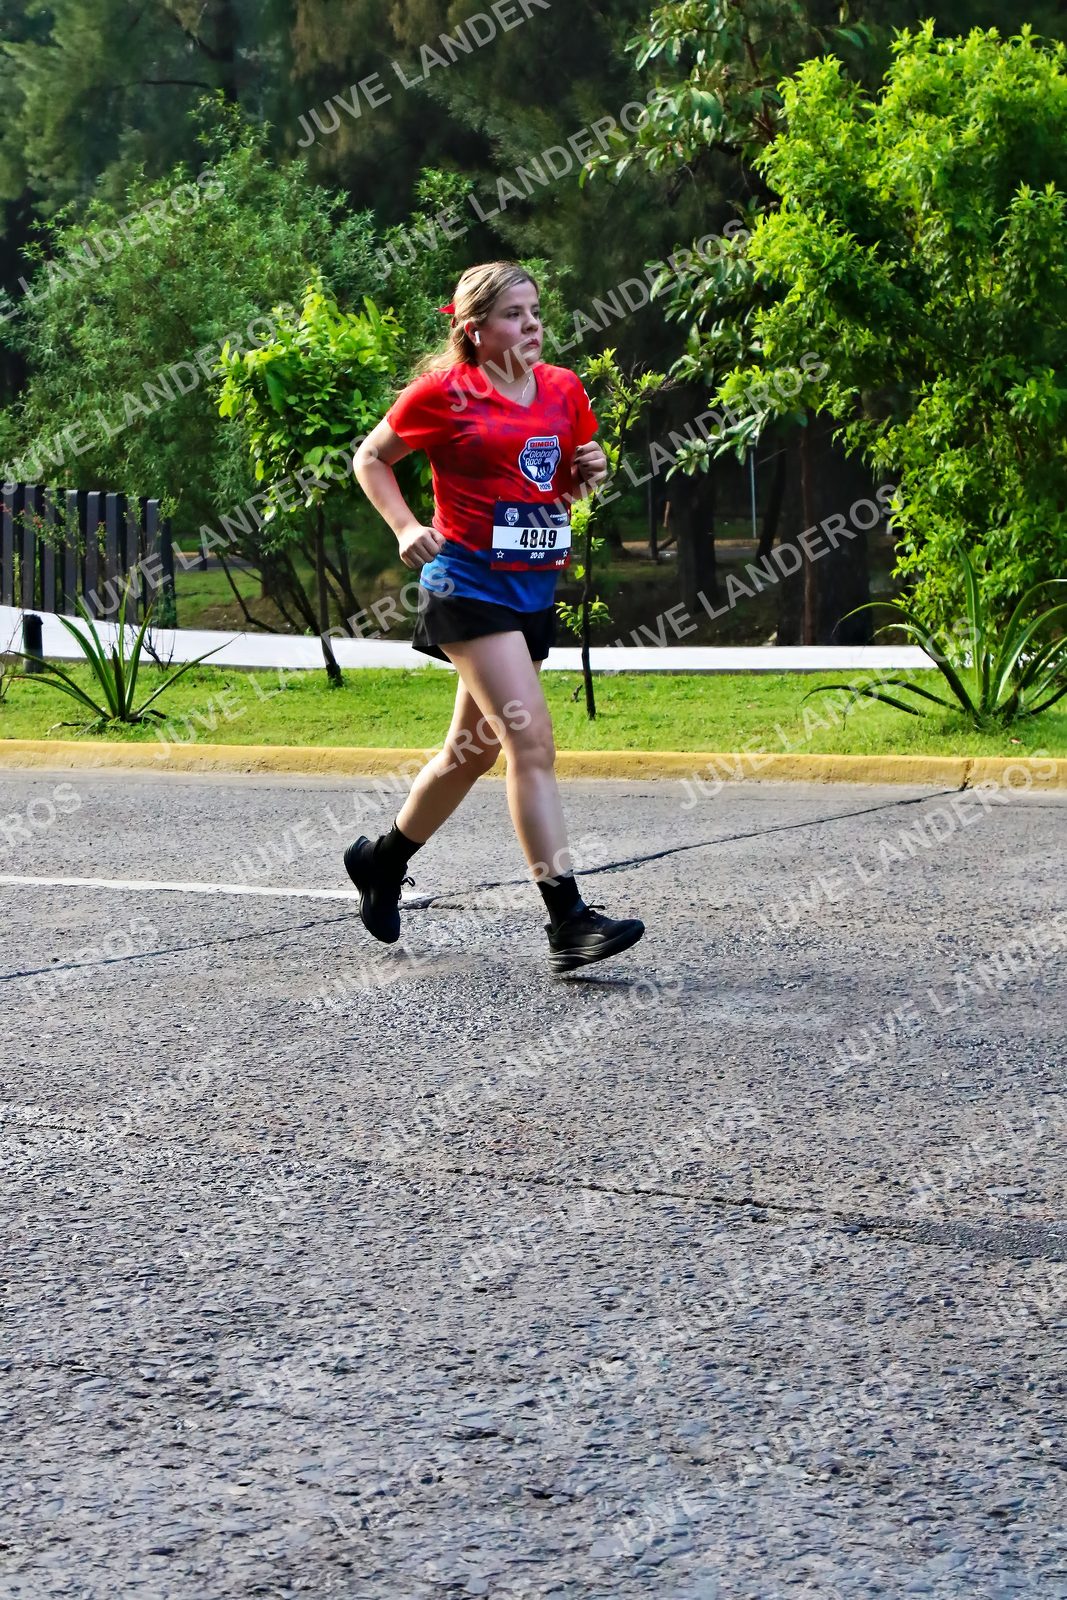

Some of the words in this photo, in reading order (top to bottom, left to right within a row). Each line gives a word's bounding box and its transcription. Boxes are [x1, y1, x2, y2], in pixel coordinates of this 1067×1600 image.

[530, 450, 553, 458] Global
[525, 458, 542, 466] Race
[520, 529, 557, 548] 4849
